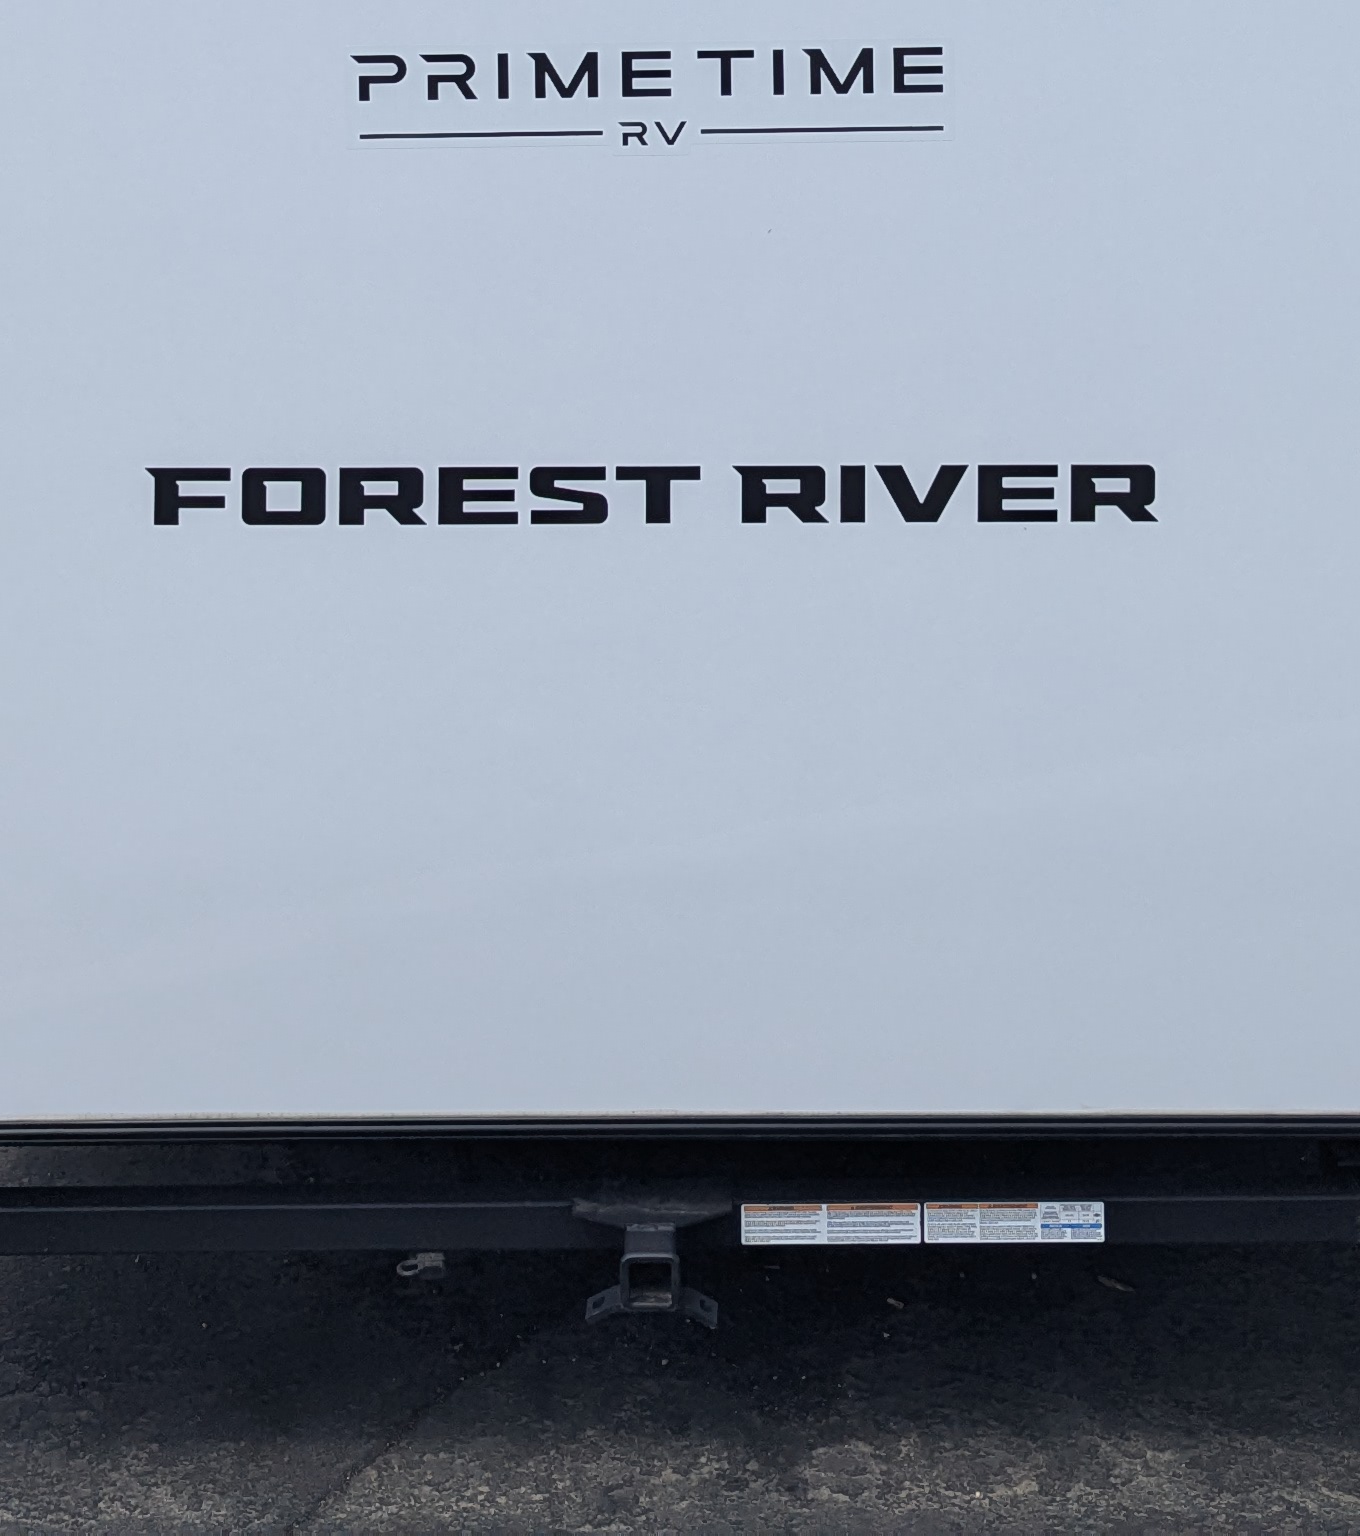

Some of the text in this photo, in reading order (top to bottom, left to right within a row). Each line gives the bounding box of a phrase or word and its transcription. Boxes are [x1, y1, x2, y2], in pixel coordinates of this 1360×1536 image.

[617, 120, 688, 147] RV
[144, 464, 1159, 526] FOREST RIVER
